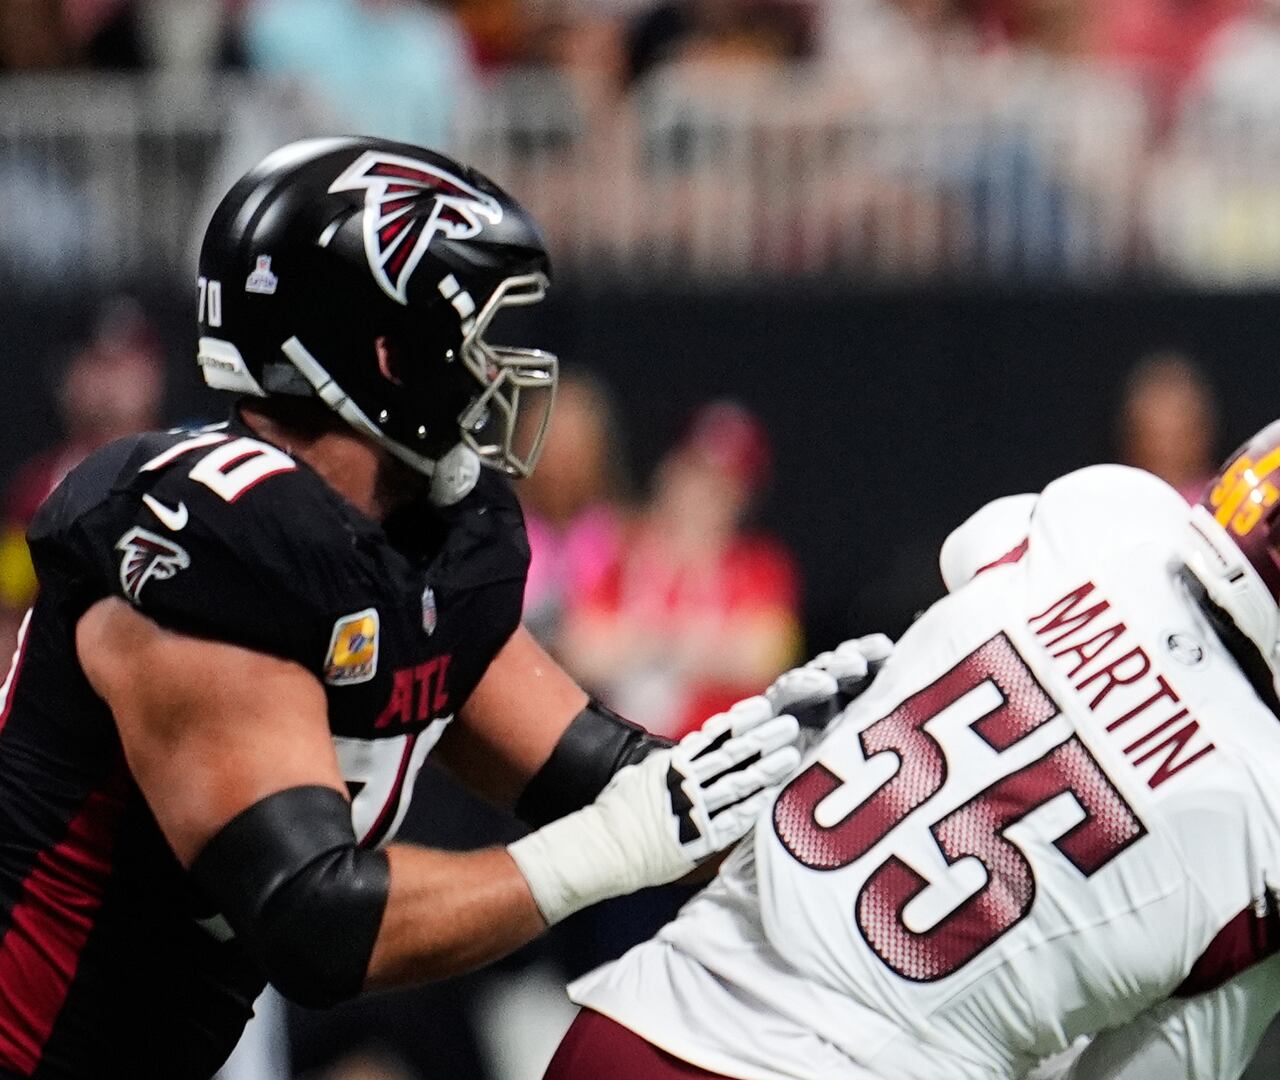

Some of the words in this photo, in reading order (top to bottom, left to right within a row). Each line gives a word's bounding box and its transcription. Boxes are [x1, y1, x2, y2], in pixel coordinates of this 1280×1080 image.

[374, 654, 452, 729] ATL
[1028, 581, 1216, 789] MARTIN
[771, 630, 1149, 983] 55
